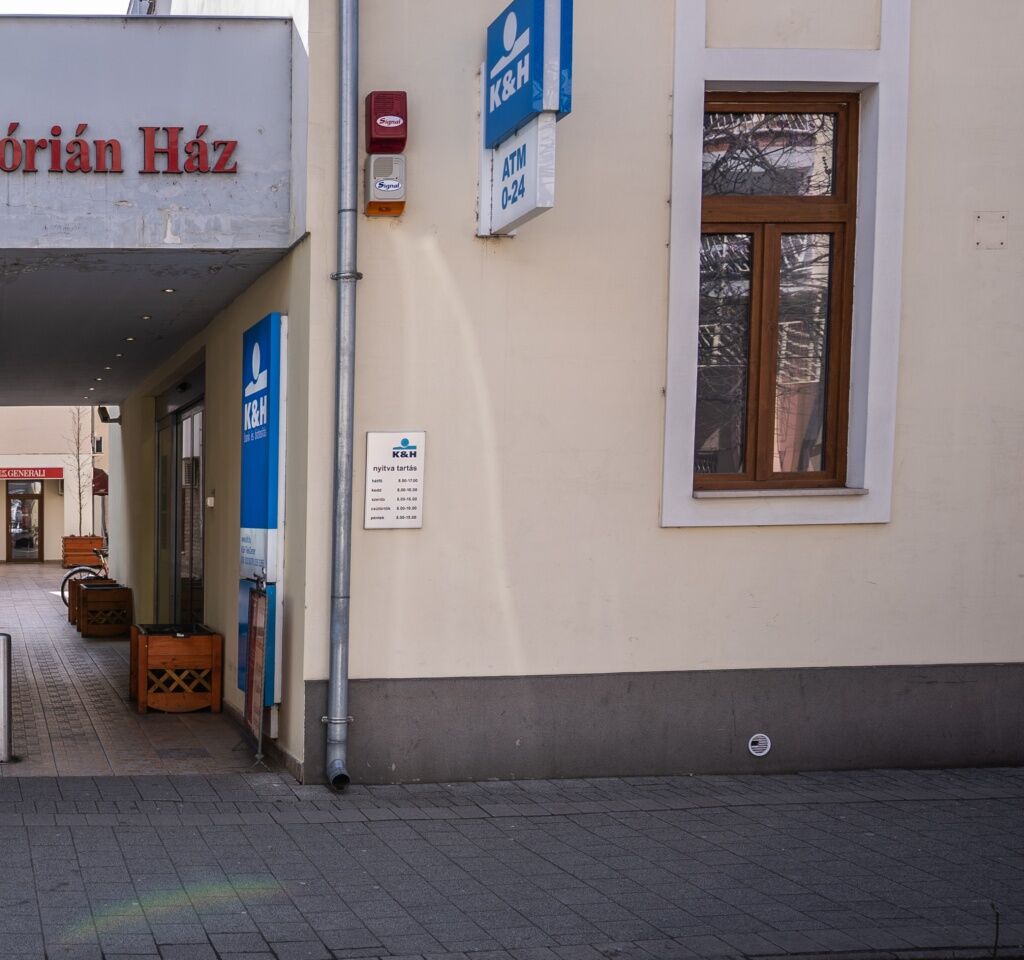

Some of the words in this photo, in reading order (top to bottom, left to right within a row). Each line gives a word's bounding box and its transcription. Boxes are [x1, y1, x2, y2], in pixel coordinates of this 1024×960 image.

[489, 53, 530, 113] K&H
[138, 124, 239, 174] Ház
[501, 143, 527, 182] ATM
[378, 180, 401, 191] Signal
[501, 174, 526, 210] 0-24
[244, 394, 268, 431] K&H
[373, 464, 395, 473] nyitva
[396, 464, 418, 472] tartás
[392, 450, 417, 459] K&H
[7, 469, 46, 478] GENERALI
